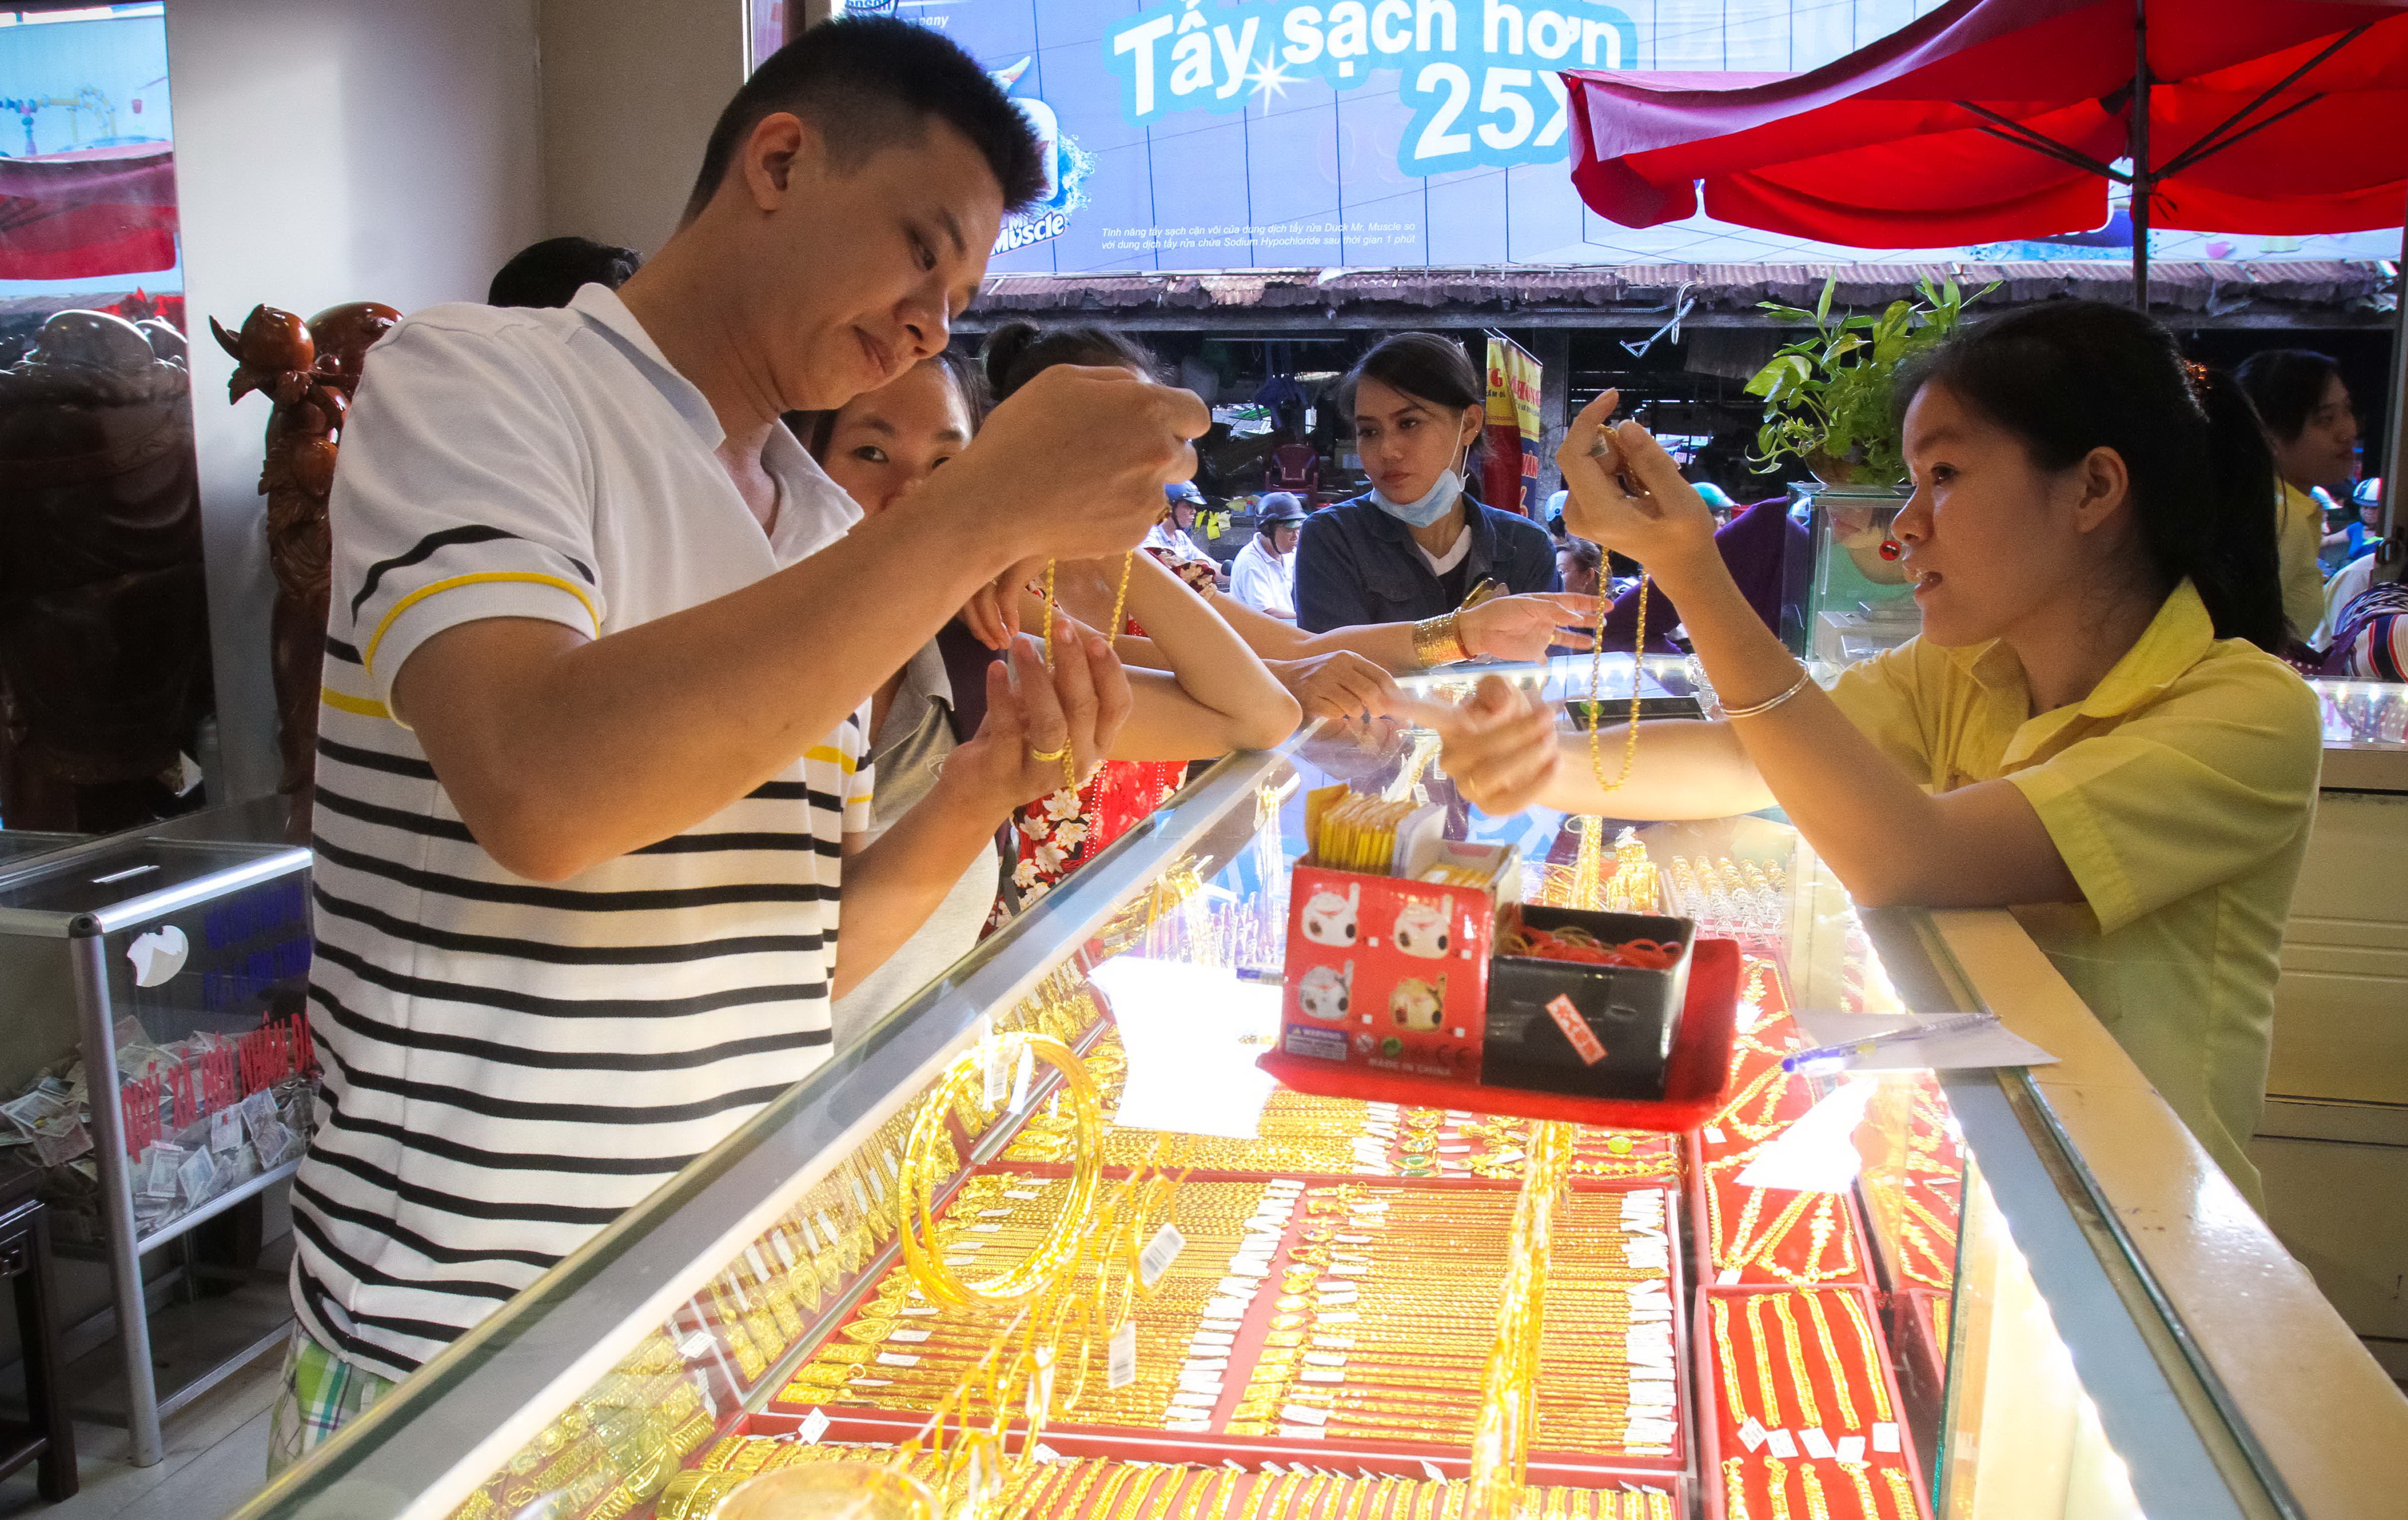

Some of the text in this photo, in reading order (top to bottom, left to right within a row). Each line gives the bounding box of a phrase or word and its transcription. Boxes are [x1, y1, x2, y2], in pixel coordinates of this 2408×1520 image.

[1283, 0, 1456, 78] sạch
[1483, 0, 1620, 69] hơn
[990, 213, 1064, 255] Muscle
[1102, 240, 1115, 249] với
[1117, 240, 1140, 251] dung
[1142, 240, 1161, 250] dịch
[1198, 238, 1221, 247] chứa
[1223, 237, 1258, 246] Sodium
[1260, 236, 1321, 248] Hypochloride
[1343, 235, 1360, 245] thời
[1363, 235, 1383, 246] gian
[1386, 235, 1391, 244] 1
[1393, 234, 1415, 246] phút
[1124, 228, 1147, 238] năng
[1165, 226, 1186, 237] sạch
[1208, 225, 1221, 234] vôi
[1223, 225, 1239, 234] của
[1242, 224, 1265, 235] dung
[1267, 224, 1287, 235] dịch
[1325, 223, 1348, 232] Duck
[1350, 222, 1364, 231] Mr.
[1368, 222, 1401, 231] Muscle
